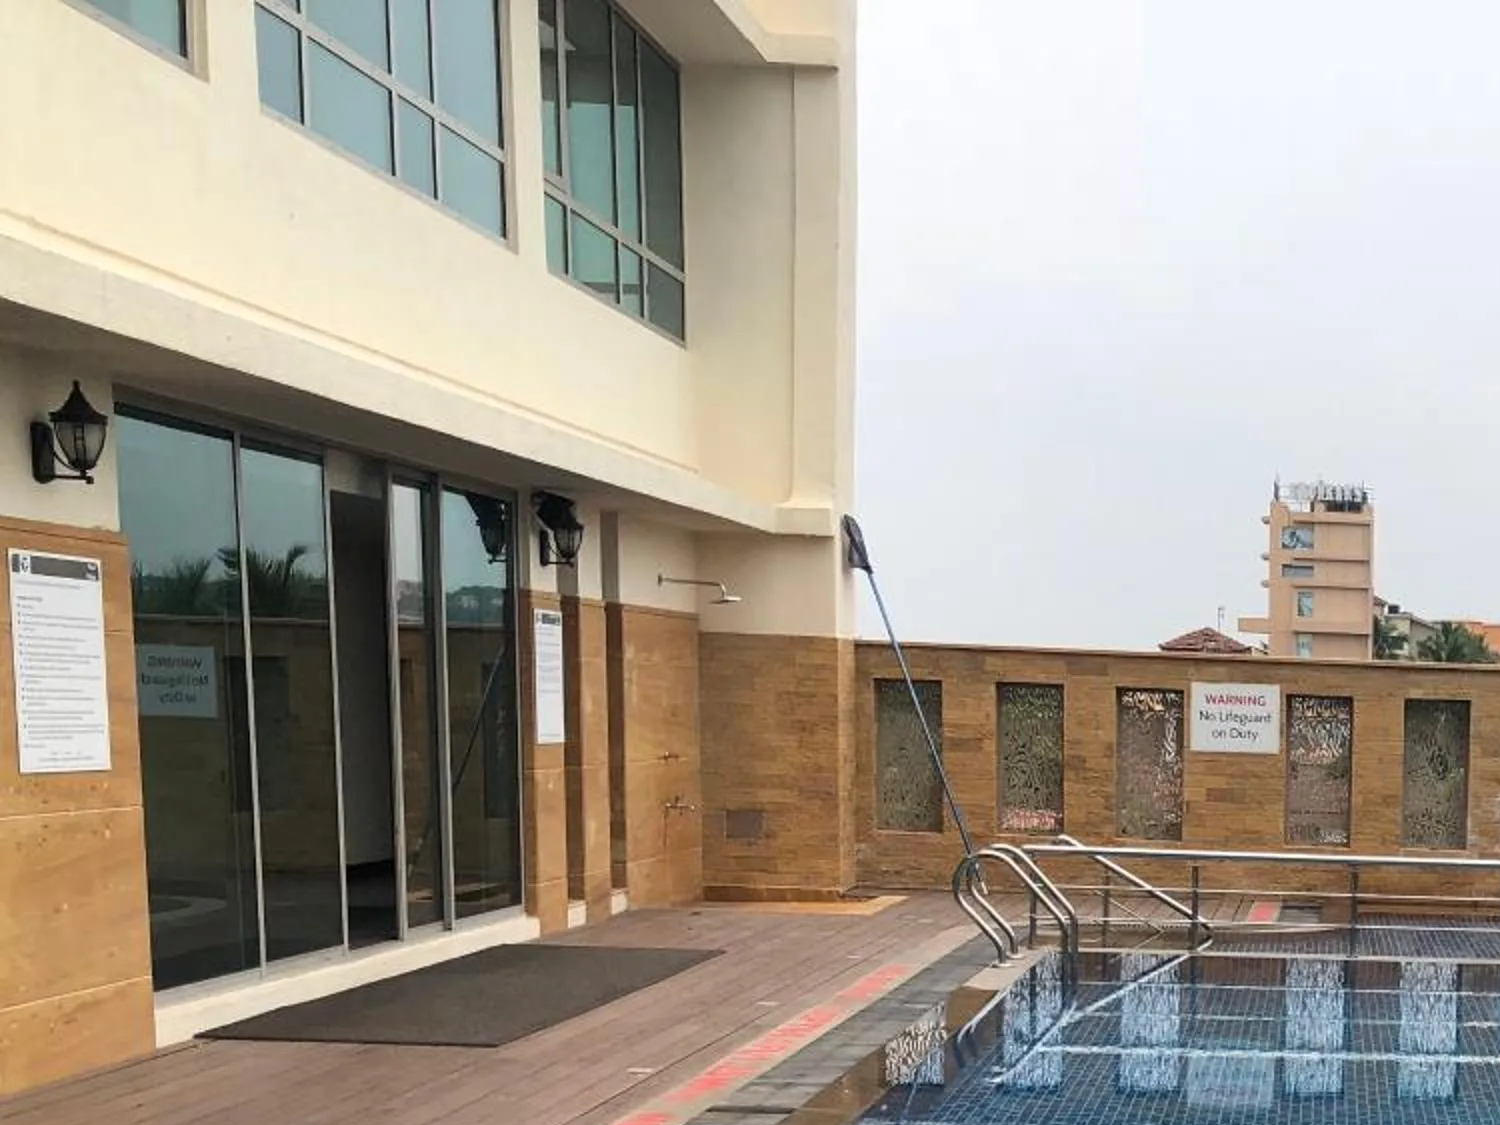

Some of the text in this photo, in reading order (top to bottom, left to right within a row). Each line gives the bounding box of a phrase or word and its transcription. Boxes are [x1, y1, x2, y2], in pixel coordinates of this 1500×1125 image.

[1205, 693, 1266, 706] WARNING
[1199, 710, 1216, 721] No
[1212, 727, 1259, 741] on Duty
